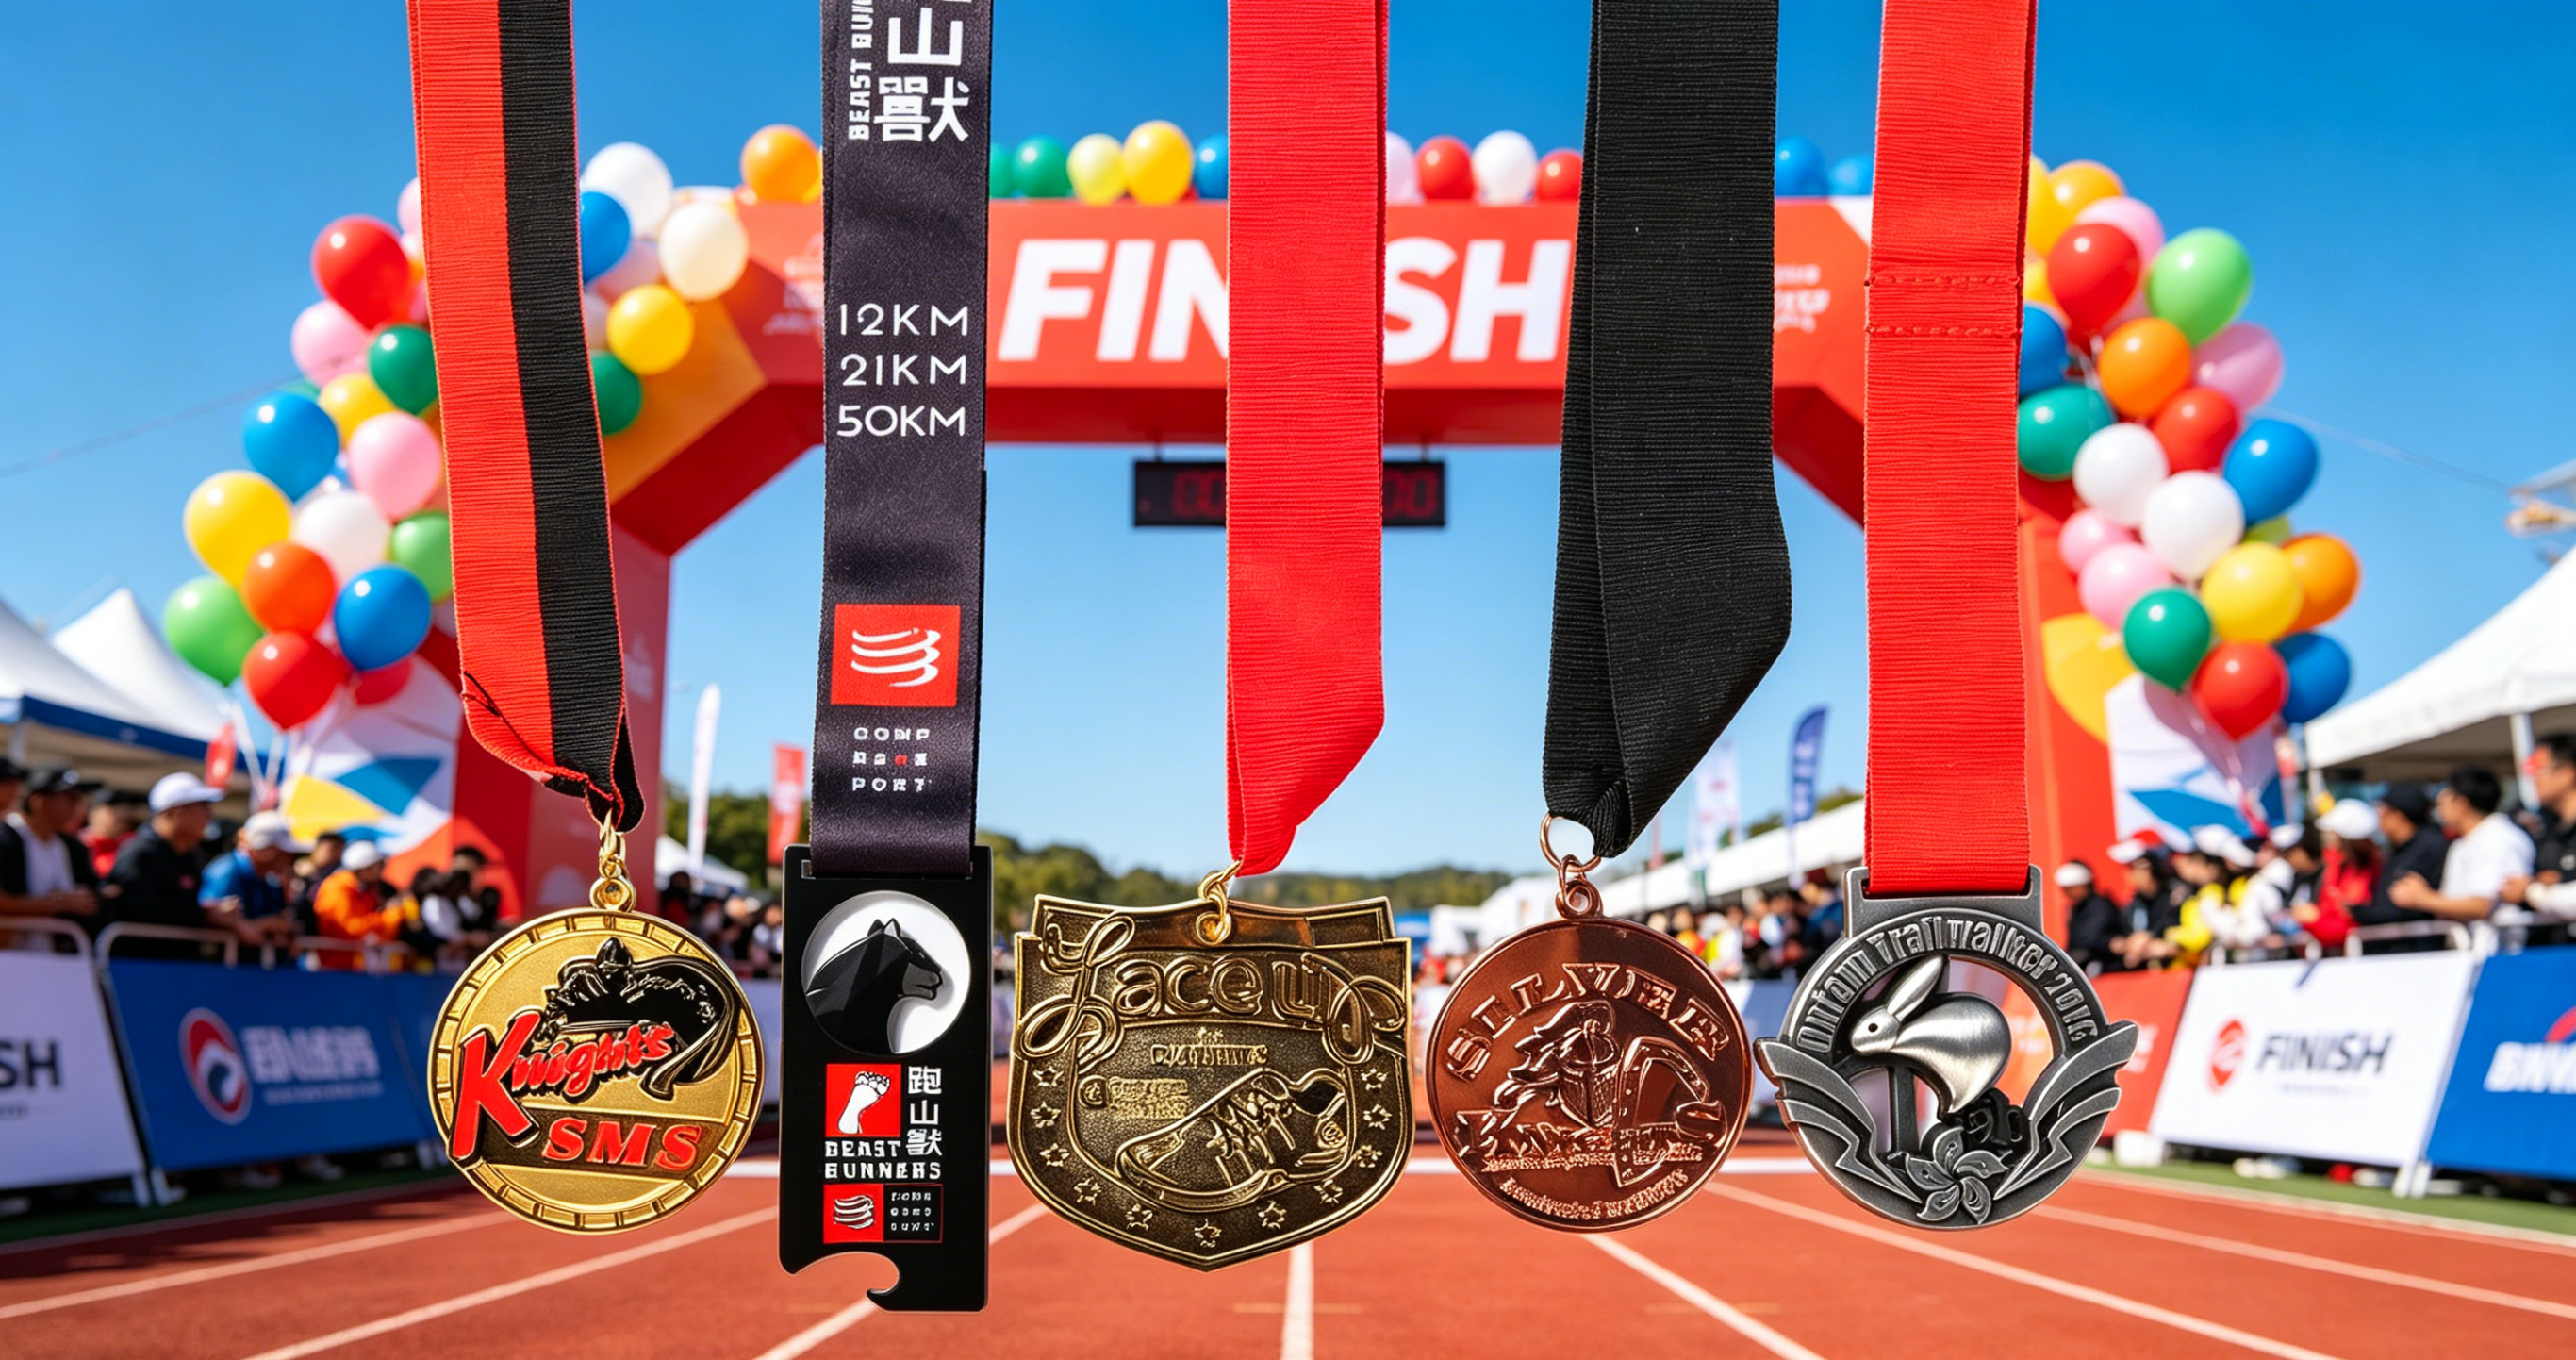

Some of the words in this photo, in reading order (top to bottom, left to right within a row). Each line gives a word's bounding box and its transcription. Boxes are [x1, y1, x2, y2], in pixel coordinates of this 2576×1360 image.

[873, 0, 971, 142] 山獸
[849, 58, 872, 141] BEAST
[839, 303, 968, 336] 12KM
[998, 236, 1572, 364] FINSH
[840, 354, 967, 386] 21KM
[837, 406, 966, 437] 50KM
[452, 1011, 675, 1160] Knights
[542, 1117, 702, 1170] SMS
[825, 1140, 901, 1157] BEAST
